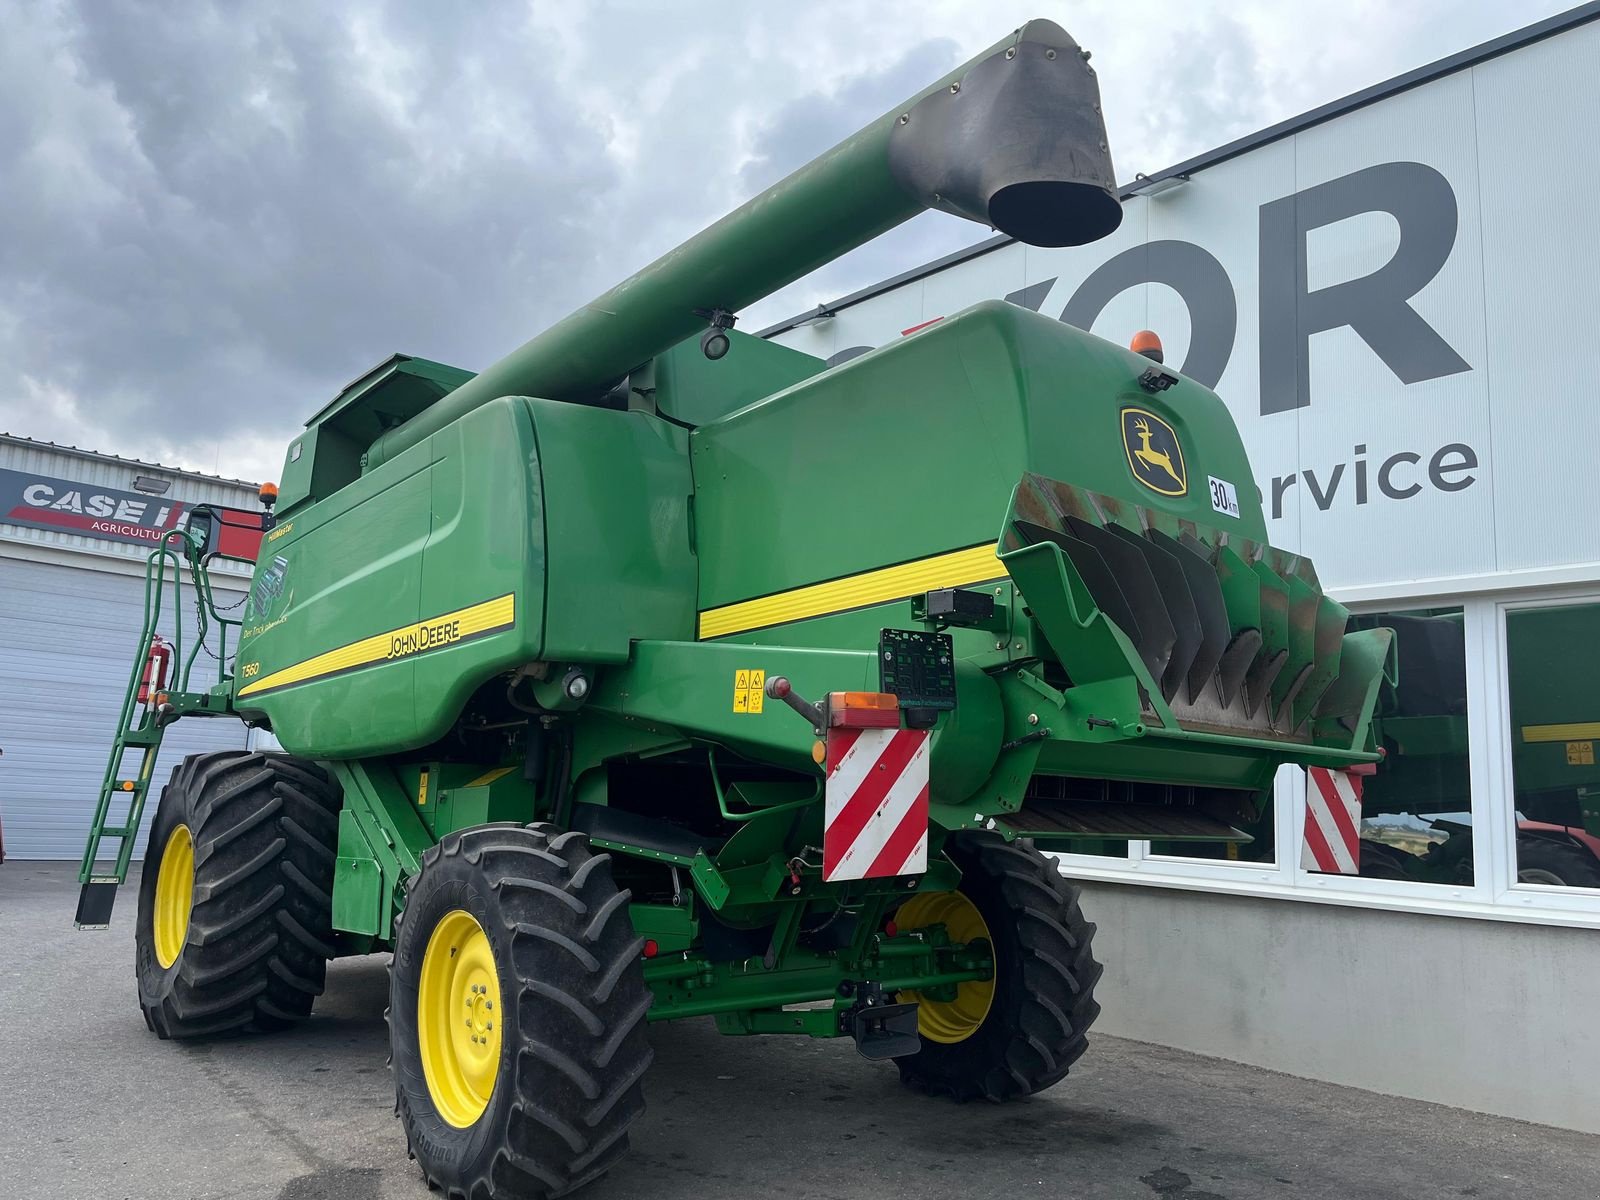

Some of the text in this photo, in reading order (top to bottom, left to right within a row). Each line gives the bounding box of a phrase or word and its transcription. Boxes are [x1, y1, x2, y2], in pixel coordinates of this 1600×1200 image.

[1210, 480, 1239, 514] 30 km
[1255, 444, 1478, 519] rvice
[23, 484, 147, 523] CASE
[388, 620, 460, 657] JOHN DEERE
[242, 662, 260, 678] T560
